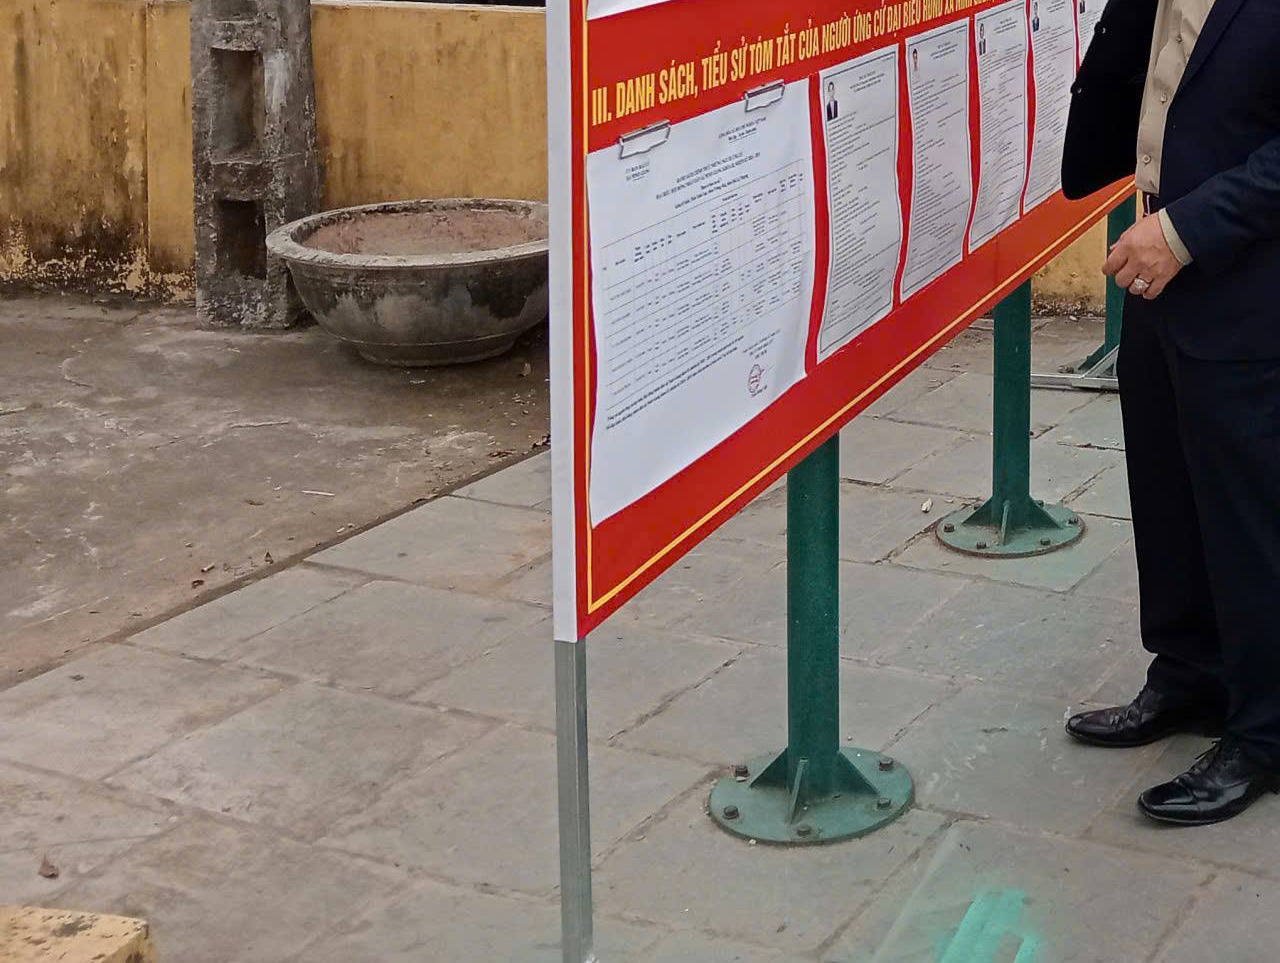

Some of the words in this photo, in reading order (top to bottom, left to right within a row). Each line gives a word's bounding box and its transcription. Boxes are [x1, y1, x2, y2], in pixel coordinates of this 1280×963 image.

[592, 86, 612, 126] III.
[616, 73, 655, 119] DANH
[659, 59, 698, 105] SÁCH,
[701, 40, 728, 91] TIỂU
[731, 36, 748, 82] SỬ
[749, 35, 774, 76] TÓM
[776, 23, 796, 68] TẮT
[799, 18, 819, 60] CỦA
[821, 15, 851, 54] NGƯỜI
[852, 9, 872, 44] ỨNG
[887, 3, 902, 37] ĐẠI
